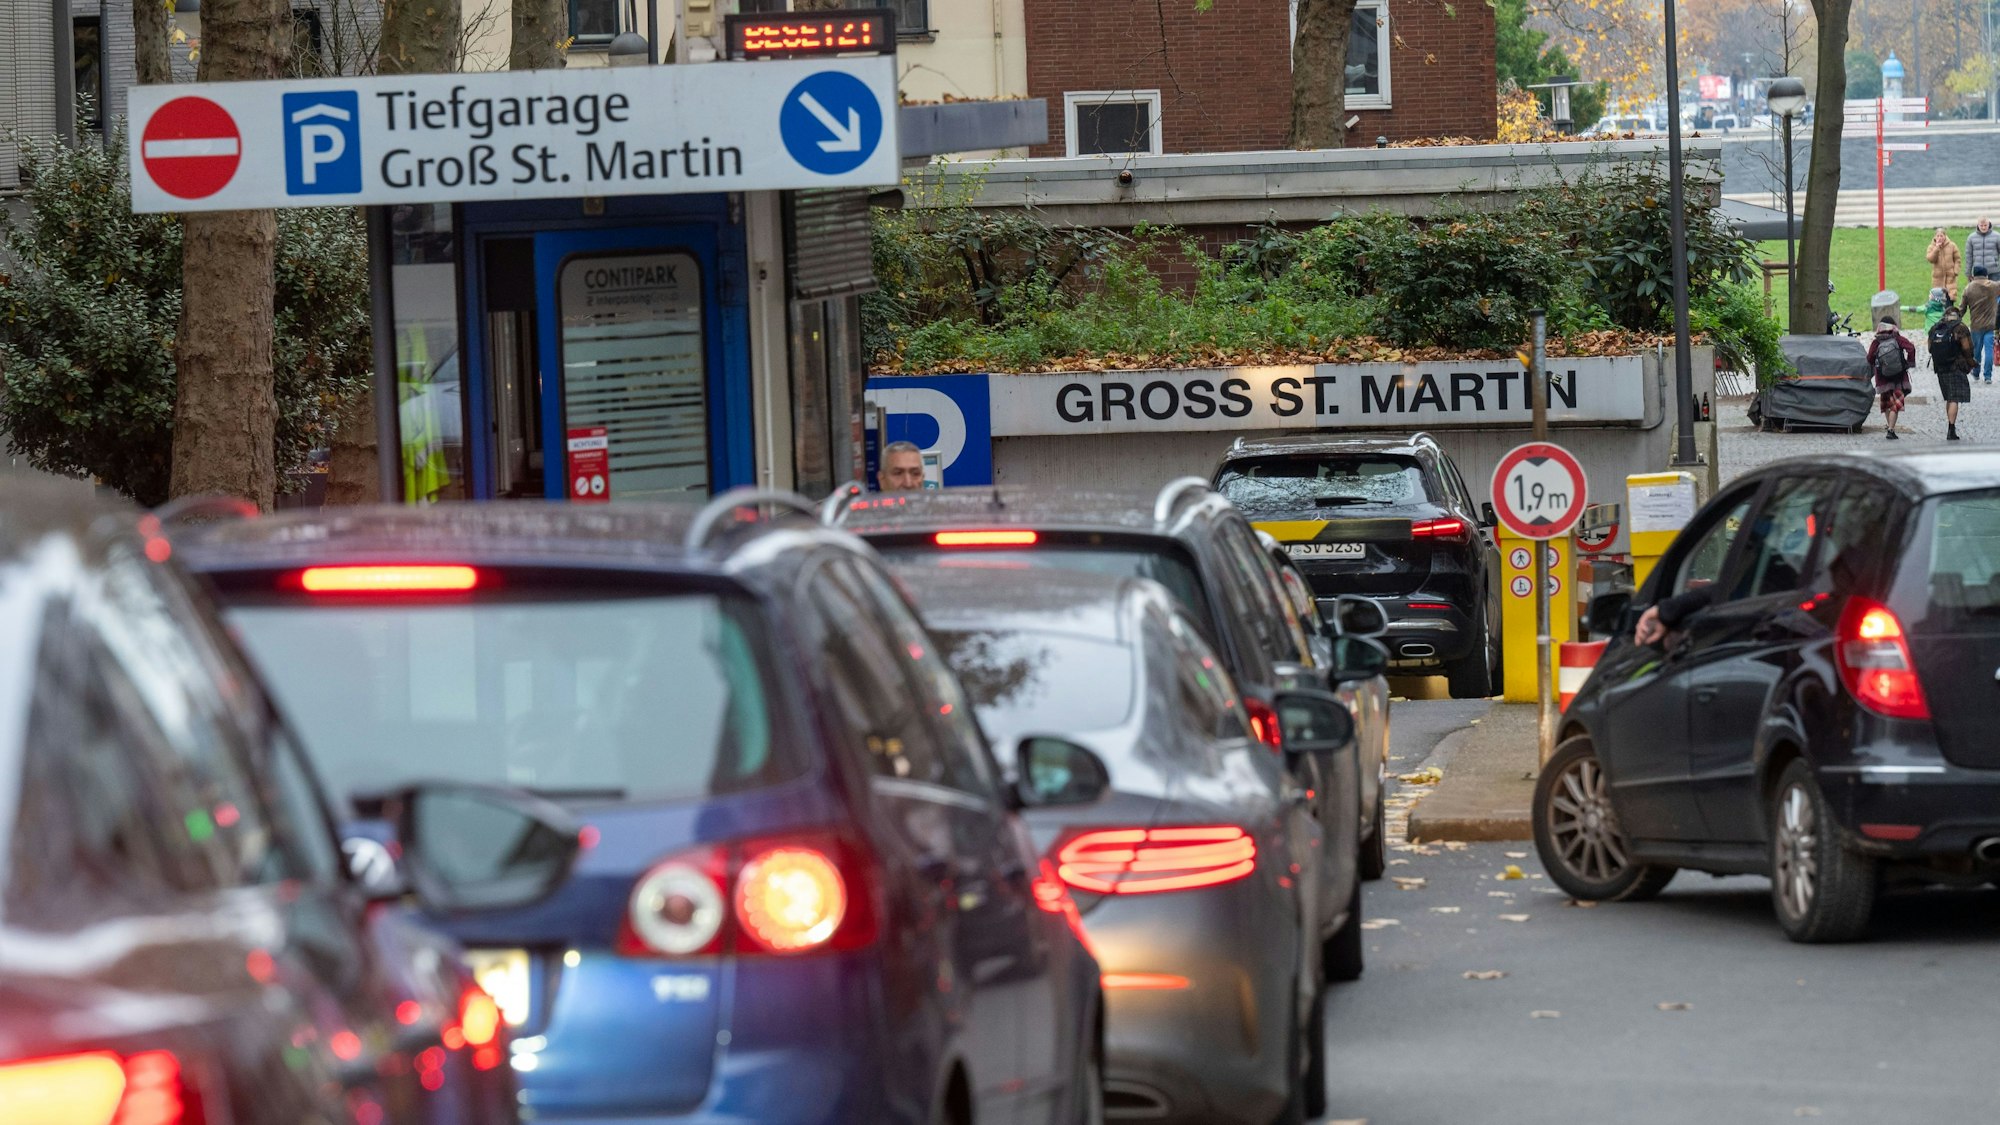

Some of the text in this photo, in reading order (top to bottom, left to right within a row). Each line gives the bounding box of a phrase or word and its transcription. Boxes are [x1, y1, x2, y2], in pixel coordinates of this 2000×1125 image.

[376, 85, 630, 140] Tiefgarage
[301, 124, 345, 184] P
[380, 136, 743, 189] Groß St. Martin
[584, 264, 678, 289] CONTIPARK
[1056, 370, 1577, 423] GROSS ST. MARTIN
[1513, 474, 1568, 513] 1,9 m
